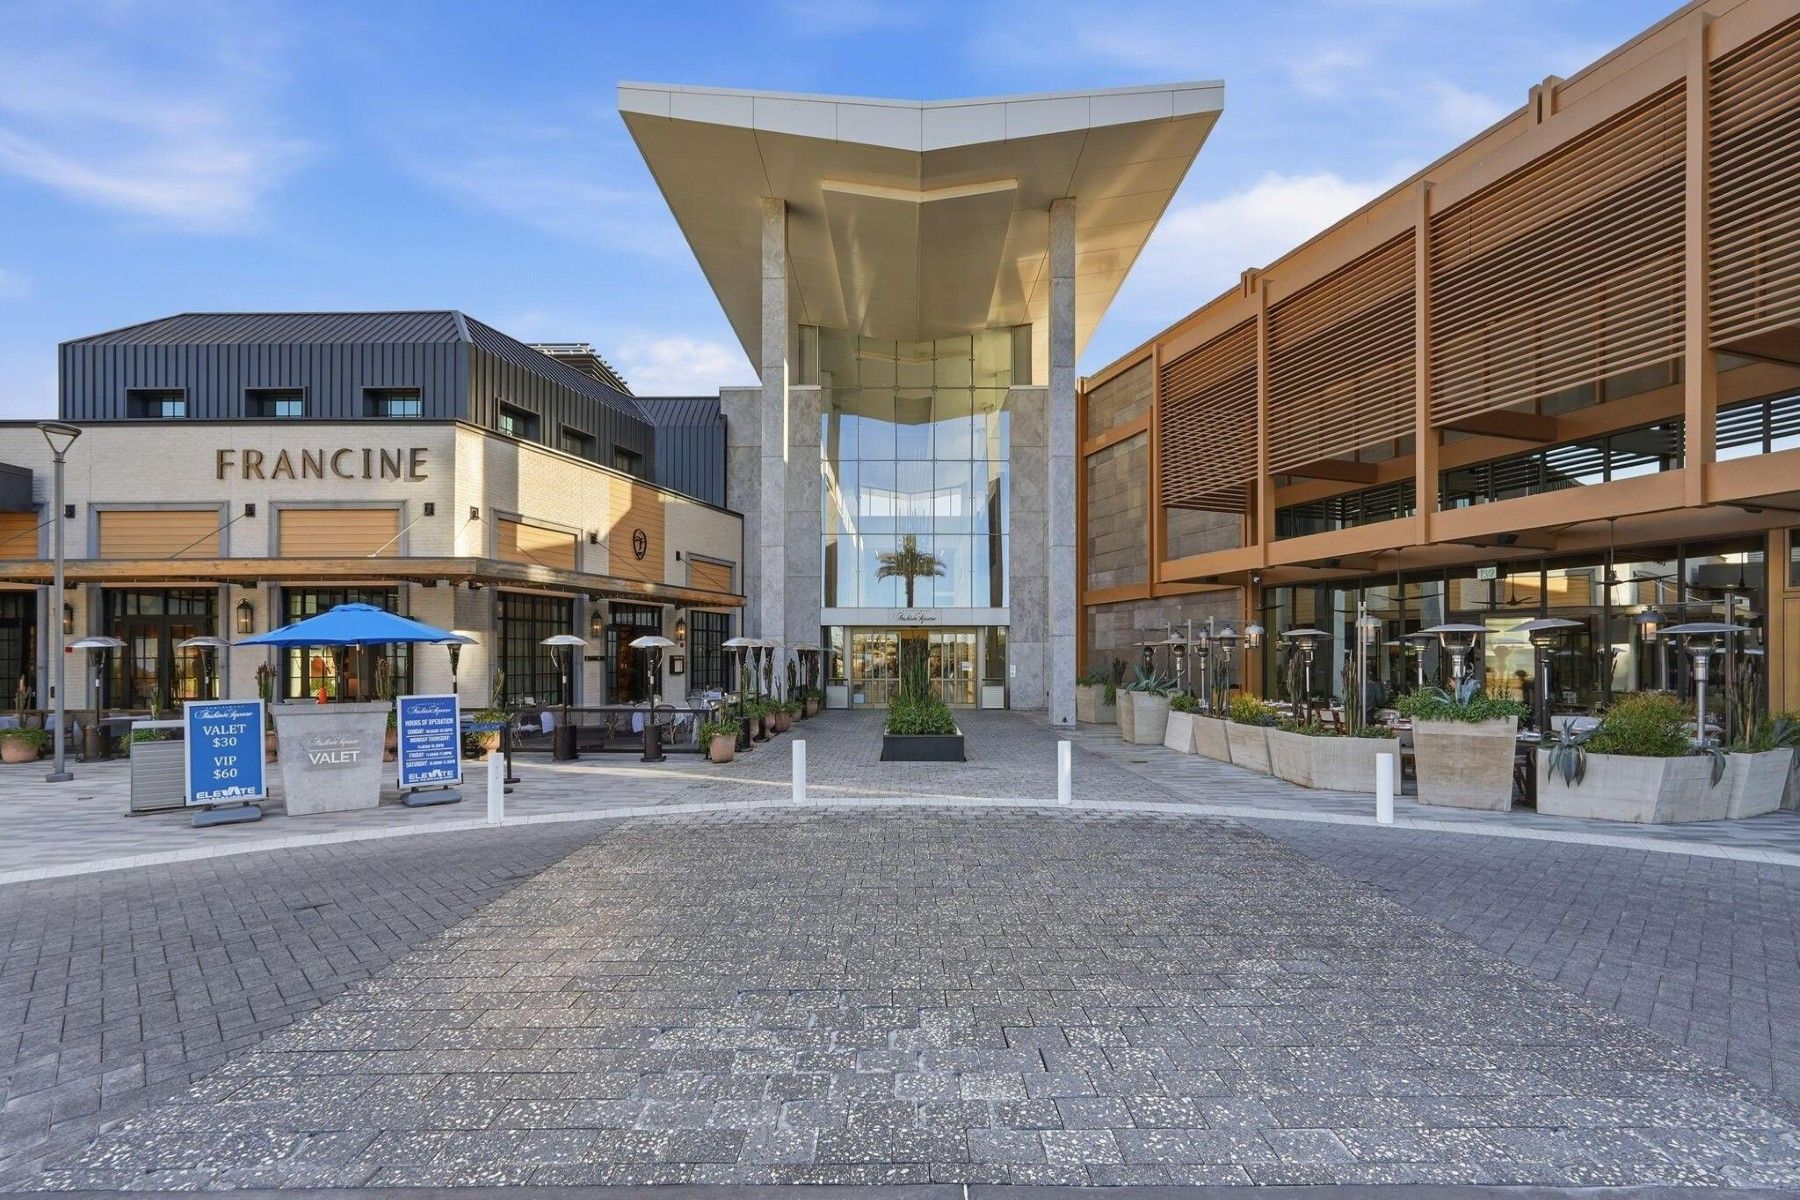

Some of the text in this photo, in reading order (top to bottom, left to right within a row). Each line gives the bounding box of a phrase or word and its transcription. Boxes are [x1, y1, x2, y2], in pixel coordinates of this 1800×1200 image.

[215, 447, 429, 480] FRANCINE
[428, 717, 454, 725] OPERATION
[203, 724, 247, 736] VALET
[212, 737, 237, 748] $30
[214, 755, 237, 767] VIP
[308, 750, 360, 765] VALET
[213, 768, 238, 780] $60
[408, 769, 454, 780] ELEVATE
[196, 786, 256, 799] ELEVATE
